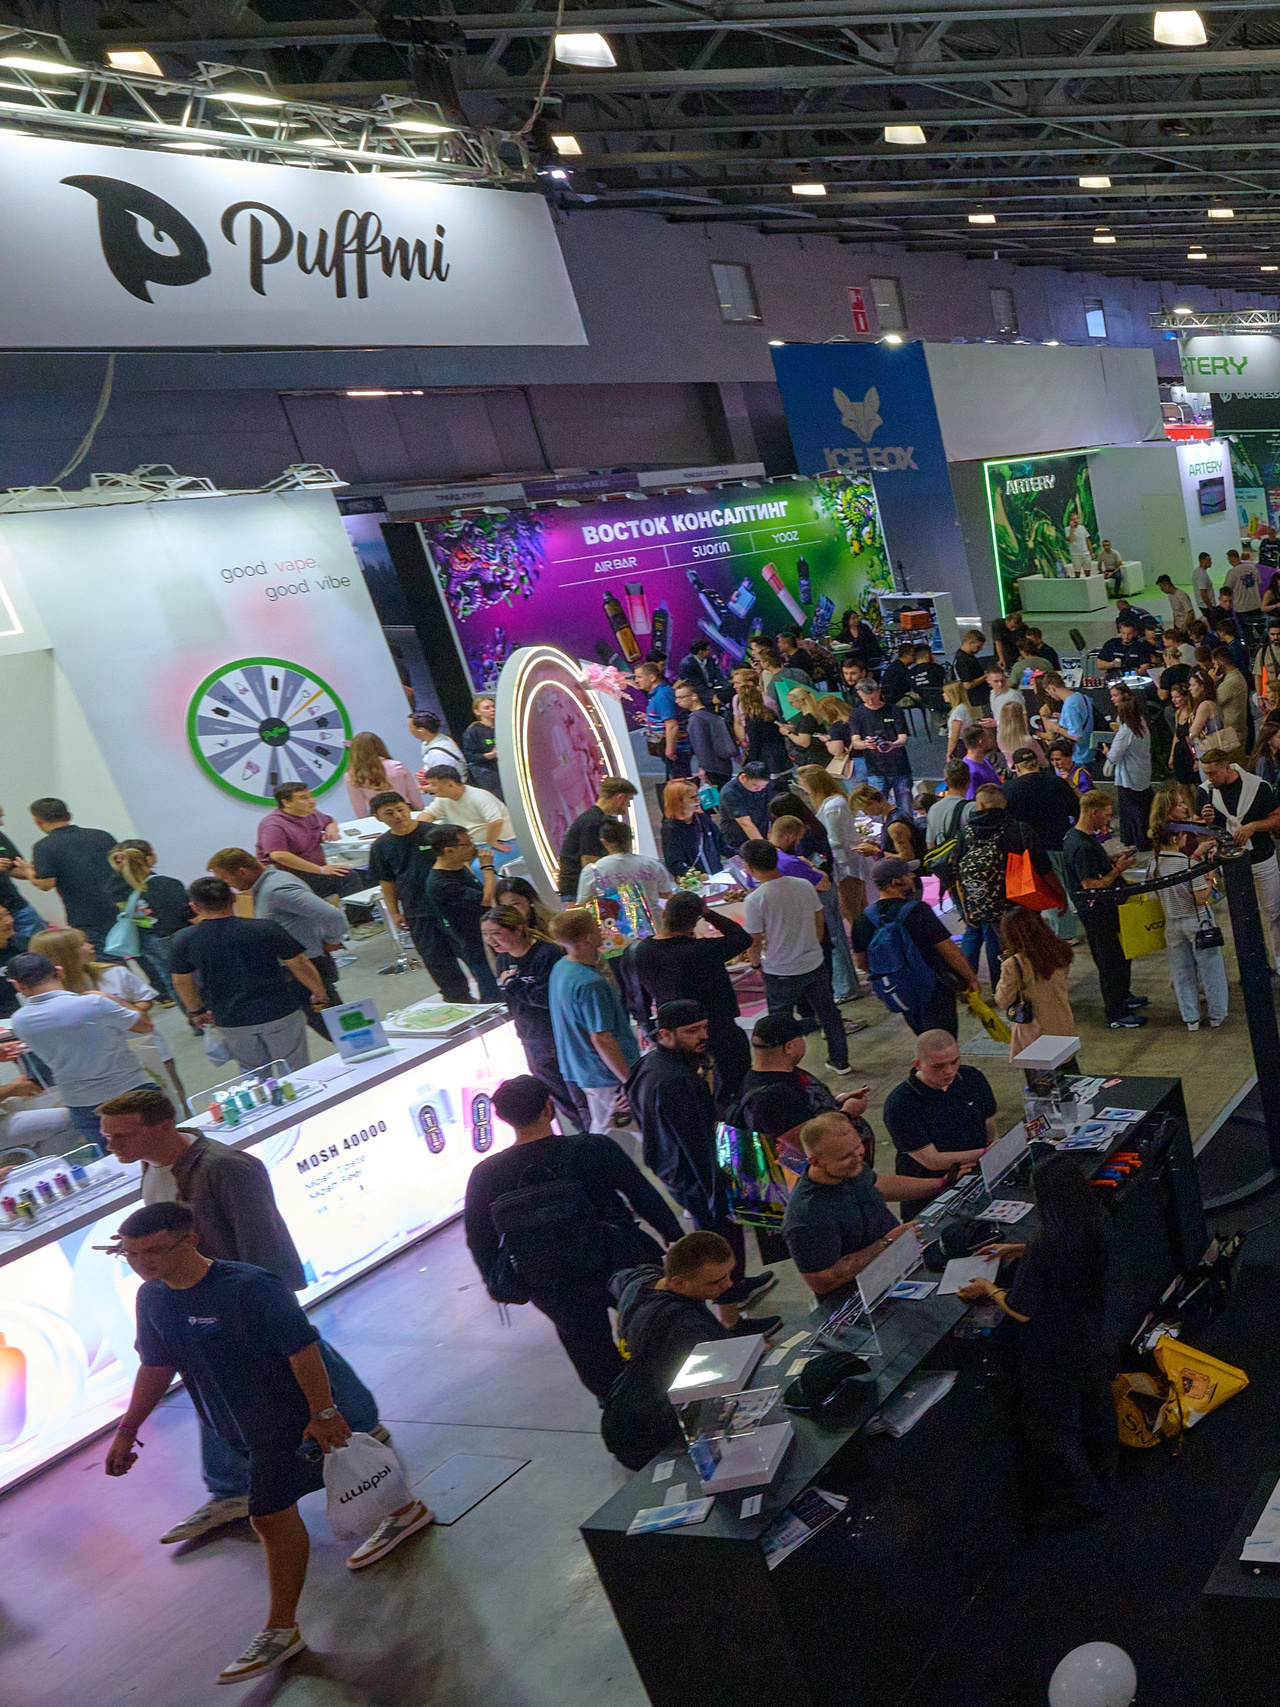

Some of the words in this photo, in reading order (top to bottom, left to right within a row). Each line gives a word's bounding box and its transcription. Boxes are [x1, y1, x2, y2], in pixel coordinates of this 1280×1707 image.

[221, 200, 450, 299] Puffmi
[1189, 460, 1223, 476] ARTERY
[1005, 474, 1056, 496] ARTERY
[581, 515, 670, 545] ВОСТОК
[671, 501, 788, 532] КОНСАЛТИНГ
[221, 561, 268, 584] good
[265, 579, 310, 601] good
[315, 575, 351, 590] vibe
[296, 1144, 340, 1175] MOSH
[343, 1120, 387, 1150] 40000
